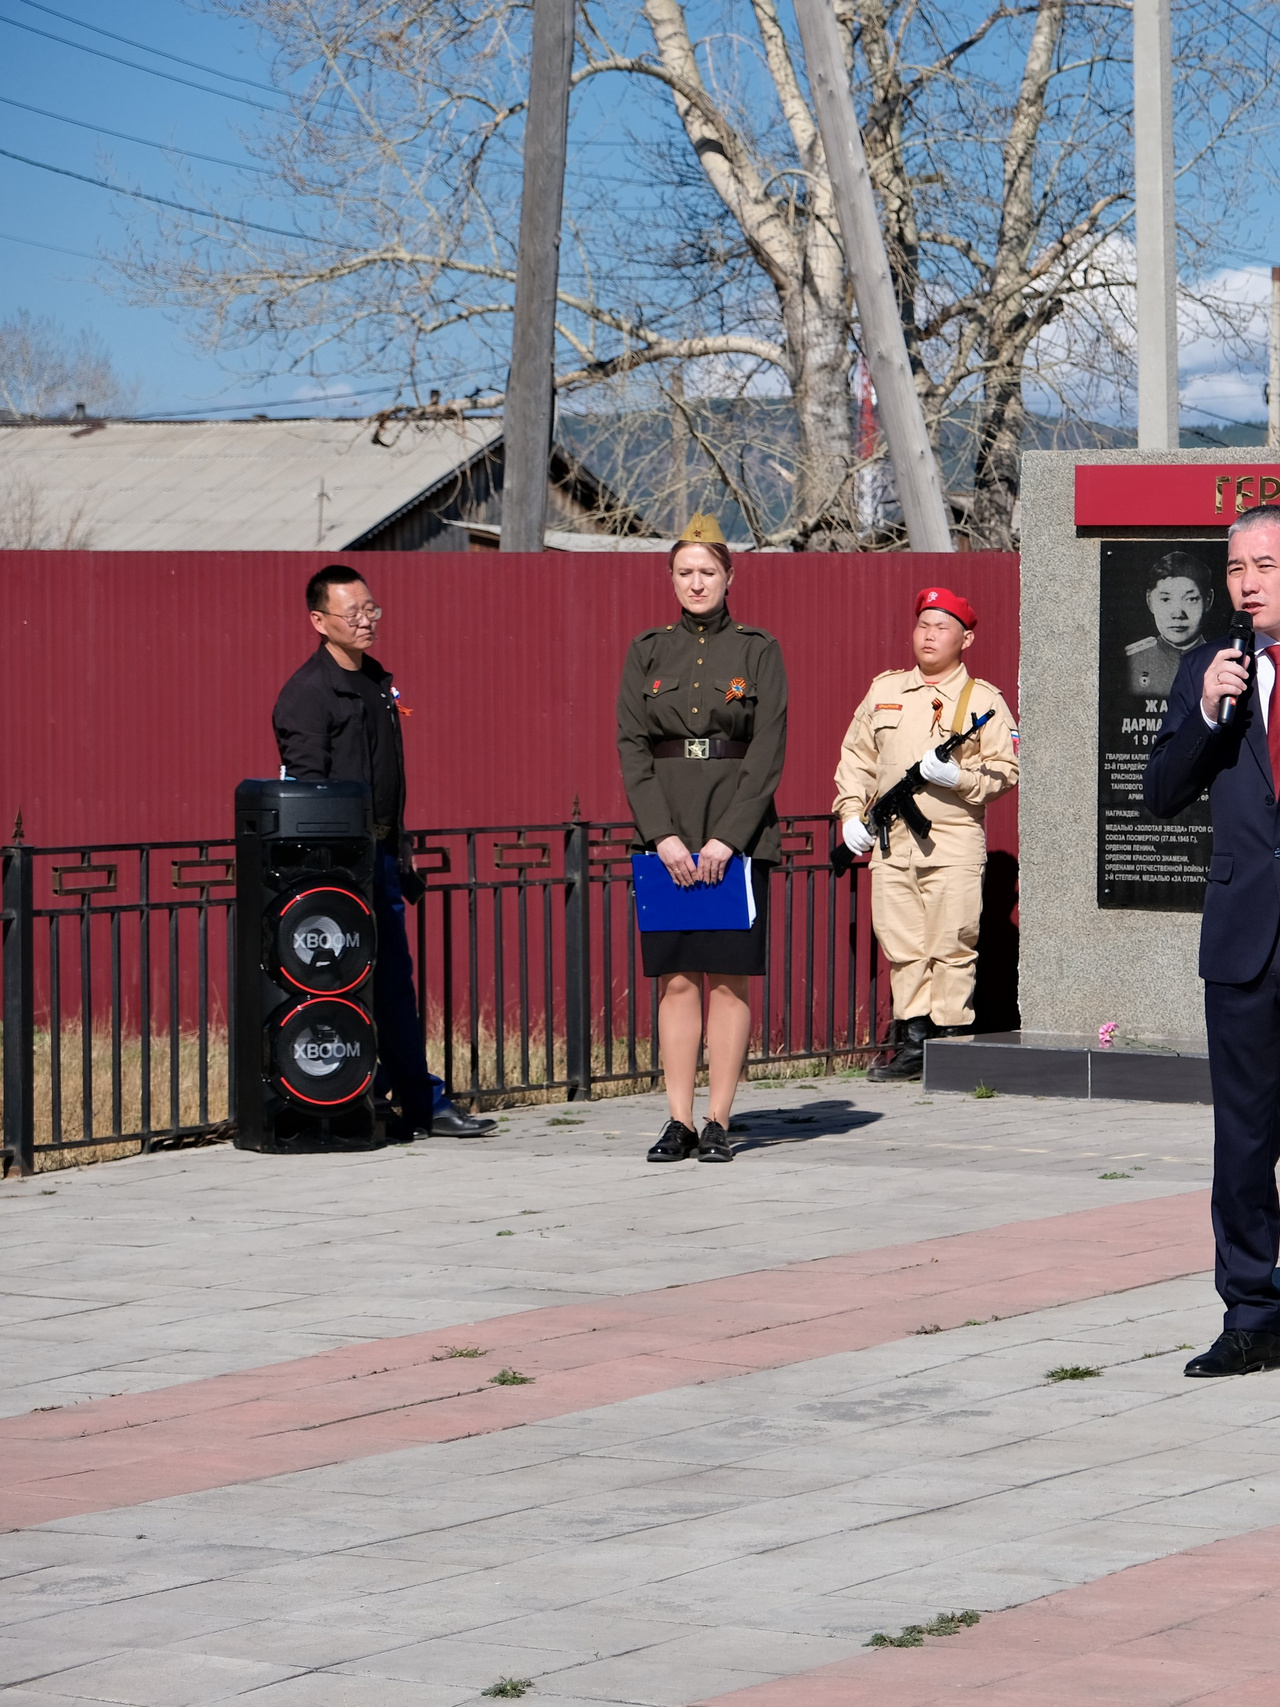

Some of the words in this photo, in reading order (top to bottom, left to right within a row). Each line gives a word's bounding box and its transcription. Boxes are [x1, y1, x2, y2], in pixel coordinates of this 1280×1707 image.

[1136, 864, 1182, 872] ОТЕЧЕСТВЕННОЙ
[1142, 874, 1170, 882] МЕДАЛЬЮ
[293, 933, 360, 948] XBOOM
[294, 1043, 360, 1059] XBOOM
